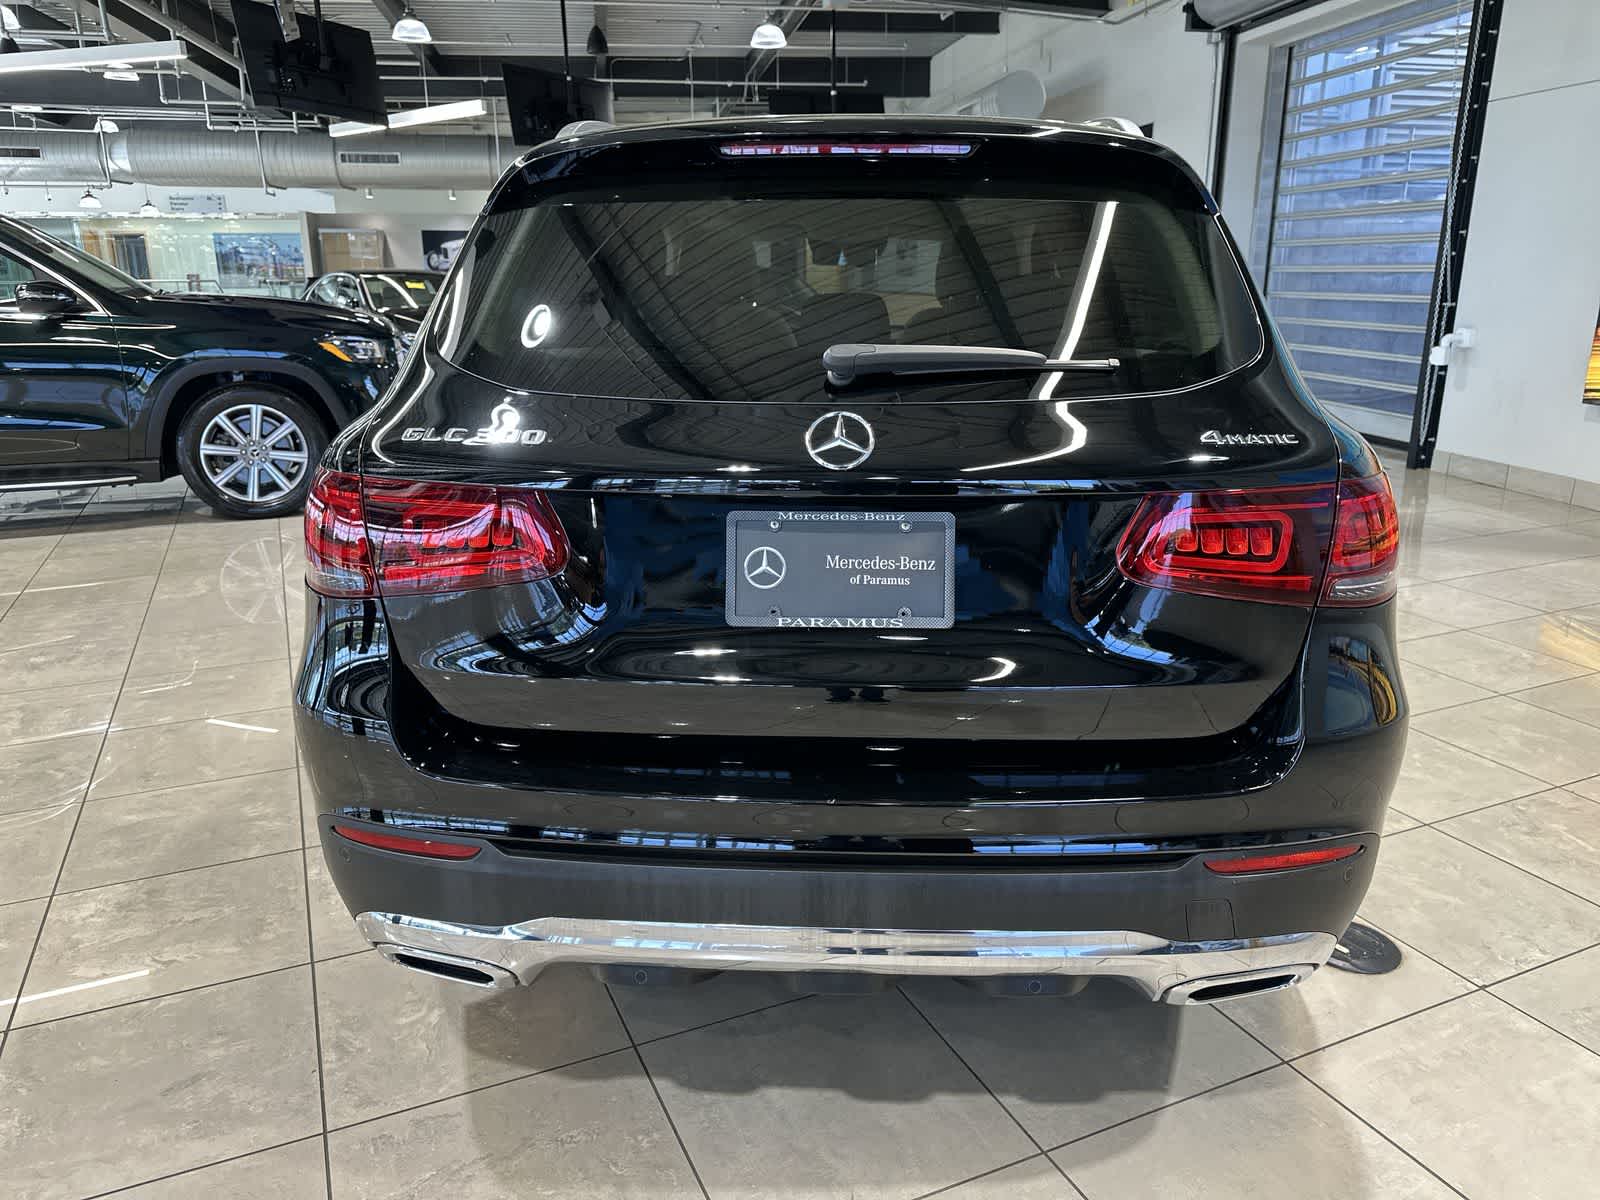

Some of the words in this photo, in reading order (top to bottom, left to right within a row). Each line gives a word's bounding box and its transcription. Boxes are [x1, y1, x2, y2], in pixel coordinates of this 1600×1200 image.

[401, 427, 468, 441] GLC
[1200, 430, 1299, 444] 4MATIC
[778, 511, 905, 521] Mercedes-Benz
[825, 554, 936, 571] Mercedes-Benz
[849, 575, 861, 585] of
[863, 575, 910, 585] Paramus
[777, 617, 903, 628] PARAMUS
